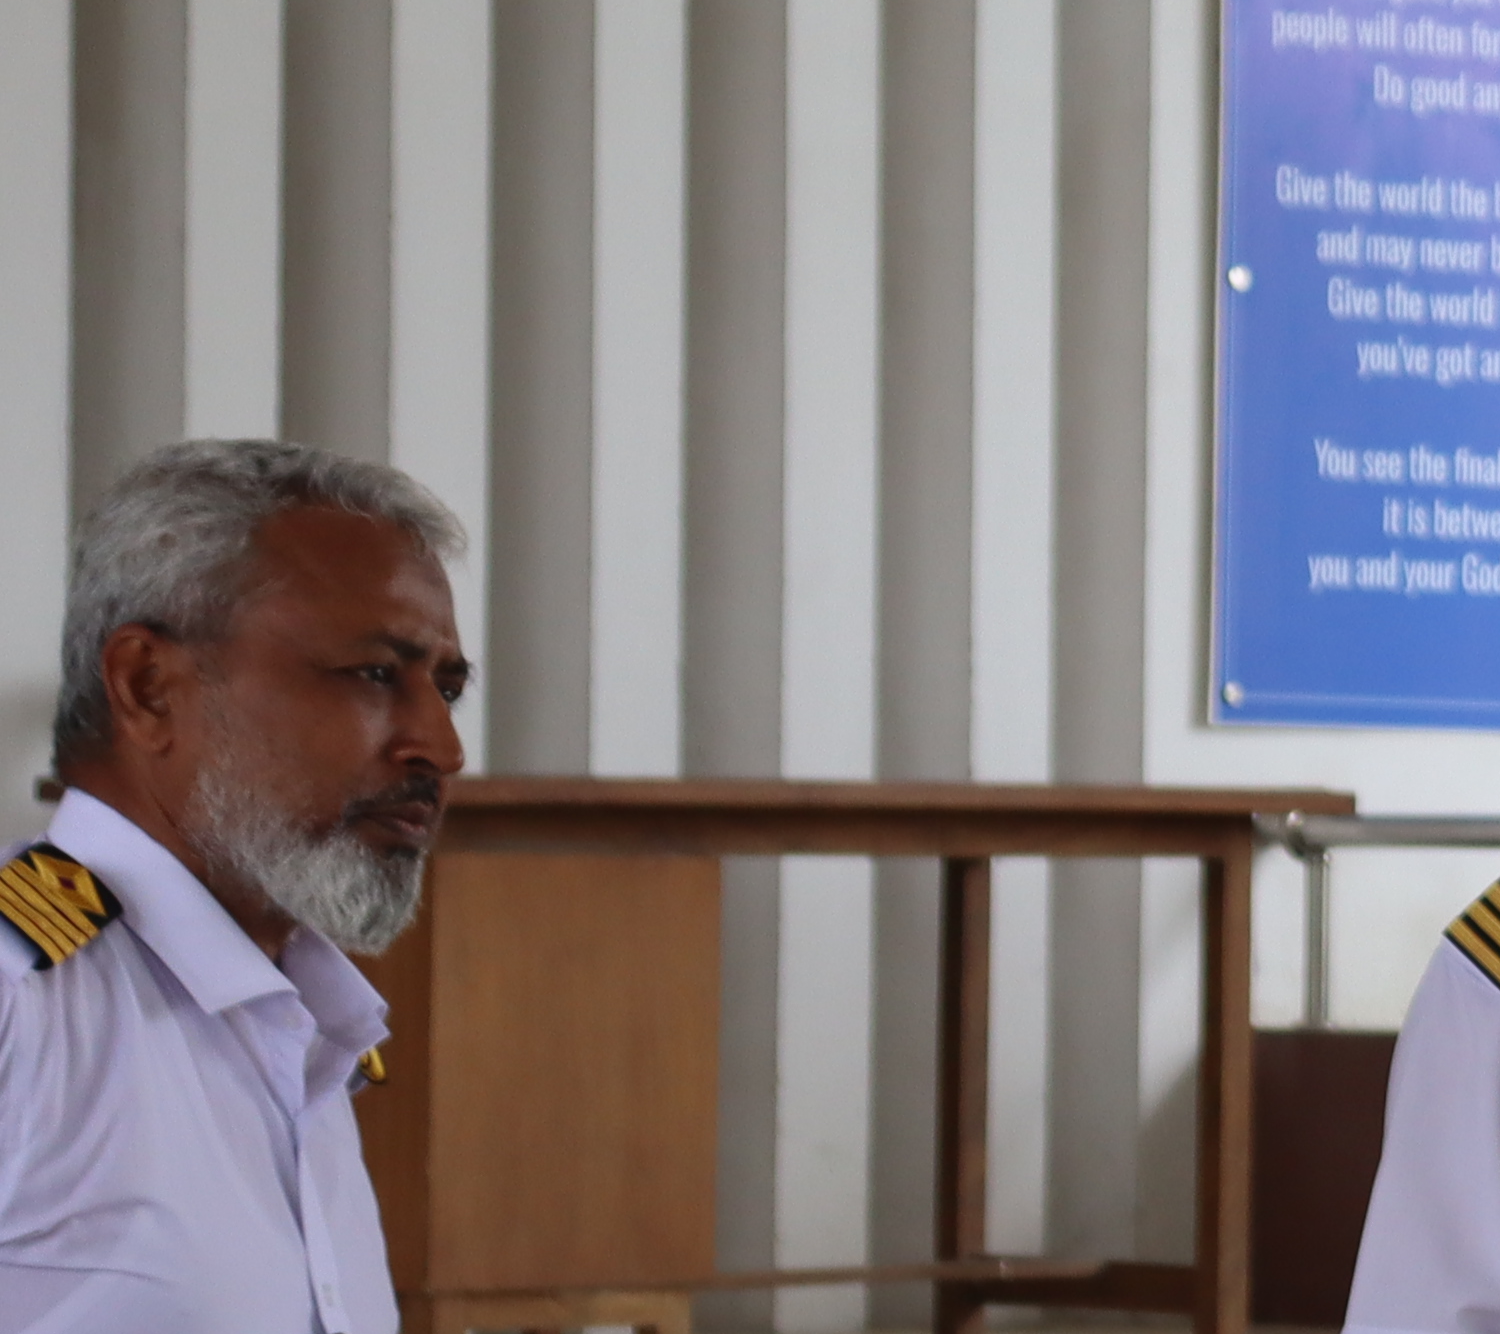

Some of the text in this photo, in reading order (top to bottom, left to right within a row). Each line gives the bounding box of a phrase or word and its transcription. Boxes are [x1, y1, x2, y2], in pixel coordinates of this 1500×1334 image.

[1272, 8, 1348, 50] people
[1356, 14, 1397, 50] will
[1404, 17, 1463, 56] often
[1373, 66, 1404, 106] Do
[1411, 74, 1466, 115] good
[1276, 165, 1328, 208] Give
[1335, 171, 1371, 211] the
[1378, 174, 1443, 216] world
[1450, 179, 1486, 219] the
[1316, 226, 1359, 264] and
[1365, 233, 1413, 269] may
[1420, 239, 1483, 271] never
[1327, 277, 1378, 320] Give
[1385, 282, 1422, 322] the
[1429, 286, 1495, 326] world
[1436, 342, 1472, 386] got
[1313, 438, 1356, 480] You
[1362, 450, 1402, 483] see
[1408, 443, 1448, 484] the
[1408, 503, 1427, 536] is
[1308, 555, 1350, 591] you
[1356, 552, 1397, 589] and
[1402, 558, 1454, 594] your
